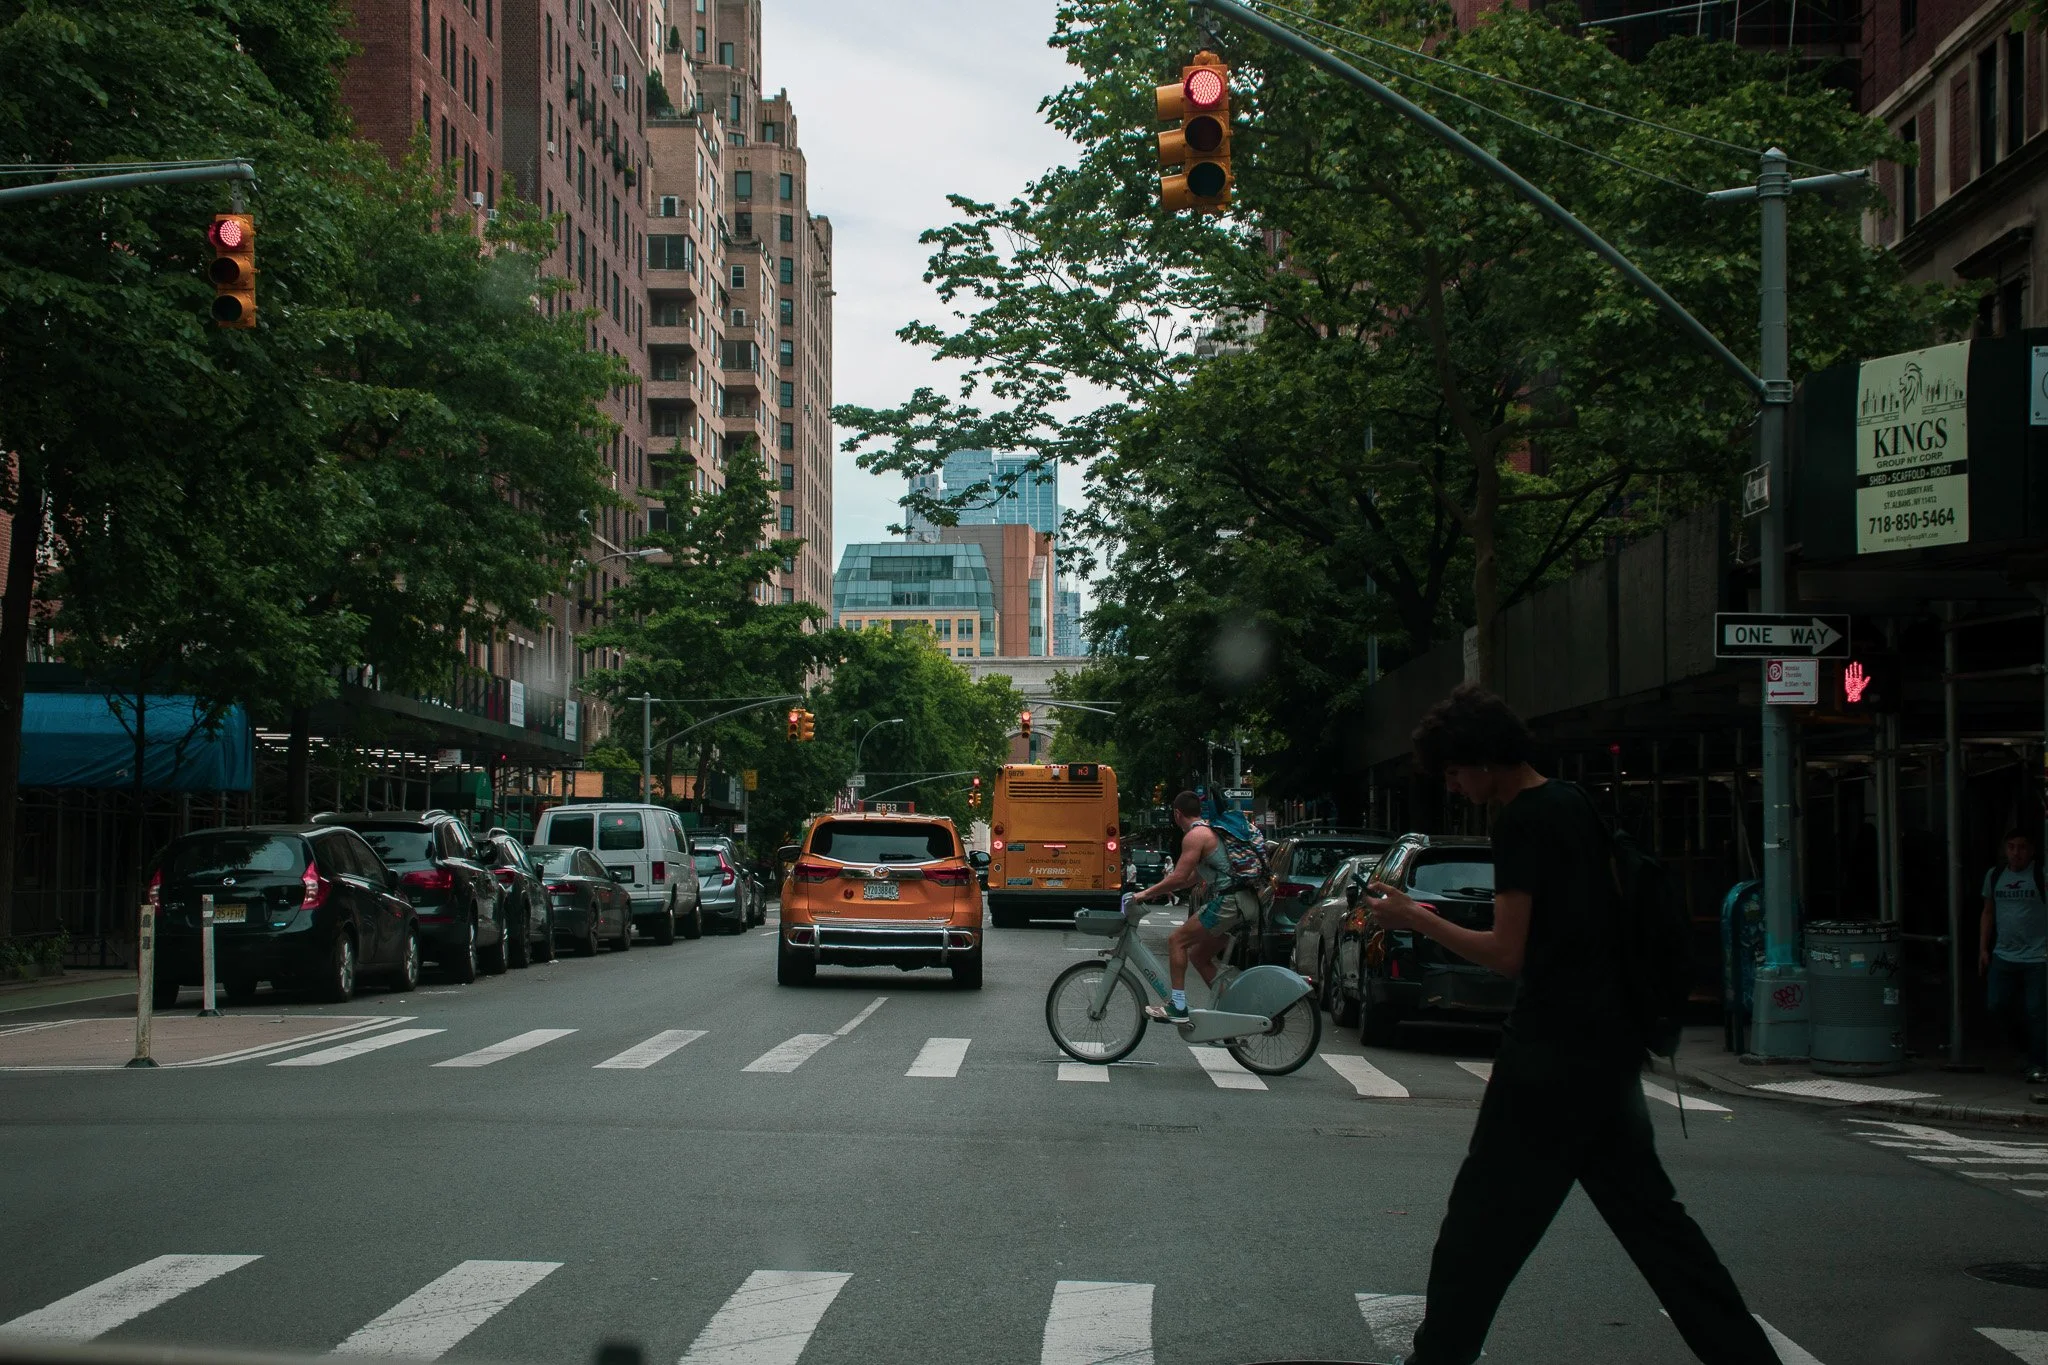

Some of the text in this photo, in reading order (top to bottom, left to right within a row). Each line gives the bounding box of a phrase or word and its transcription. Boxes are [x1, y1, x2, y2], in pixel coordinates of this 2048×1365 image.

[1873, 418, 1947, 458] KINGS
[1876, 452, 1944, 469] GROUP NY CORP.
[1869, 464, 1953, 486] SHED SCAFFOLD HOIST
[1923, 485, 1934, 493] AVE
[1869, 508, 1955, 534] 718-850-5464
[1735, 627, 1830, 644] ONE WAY
